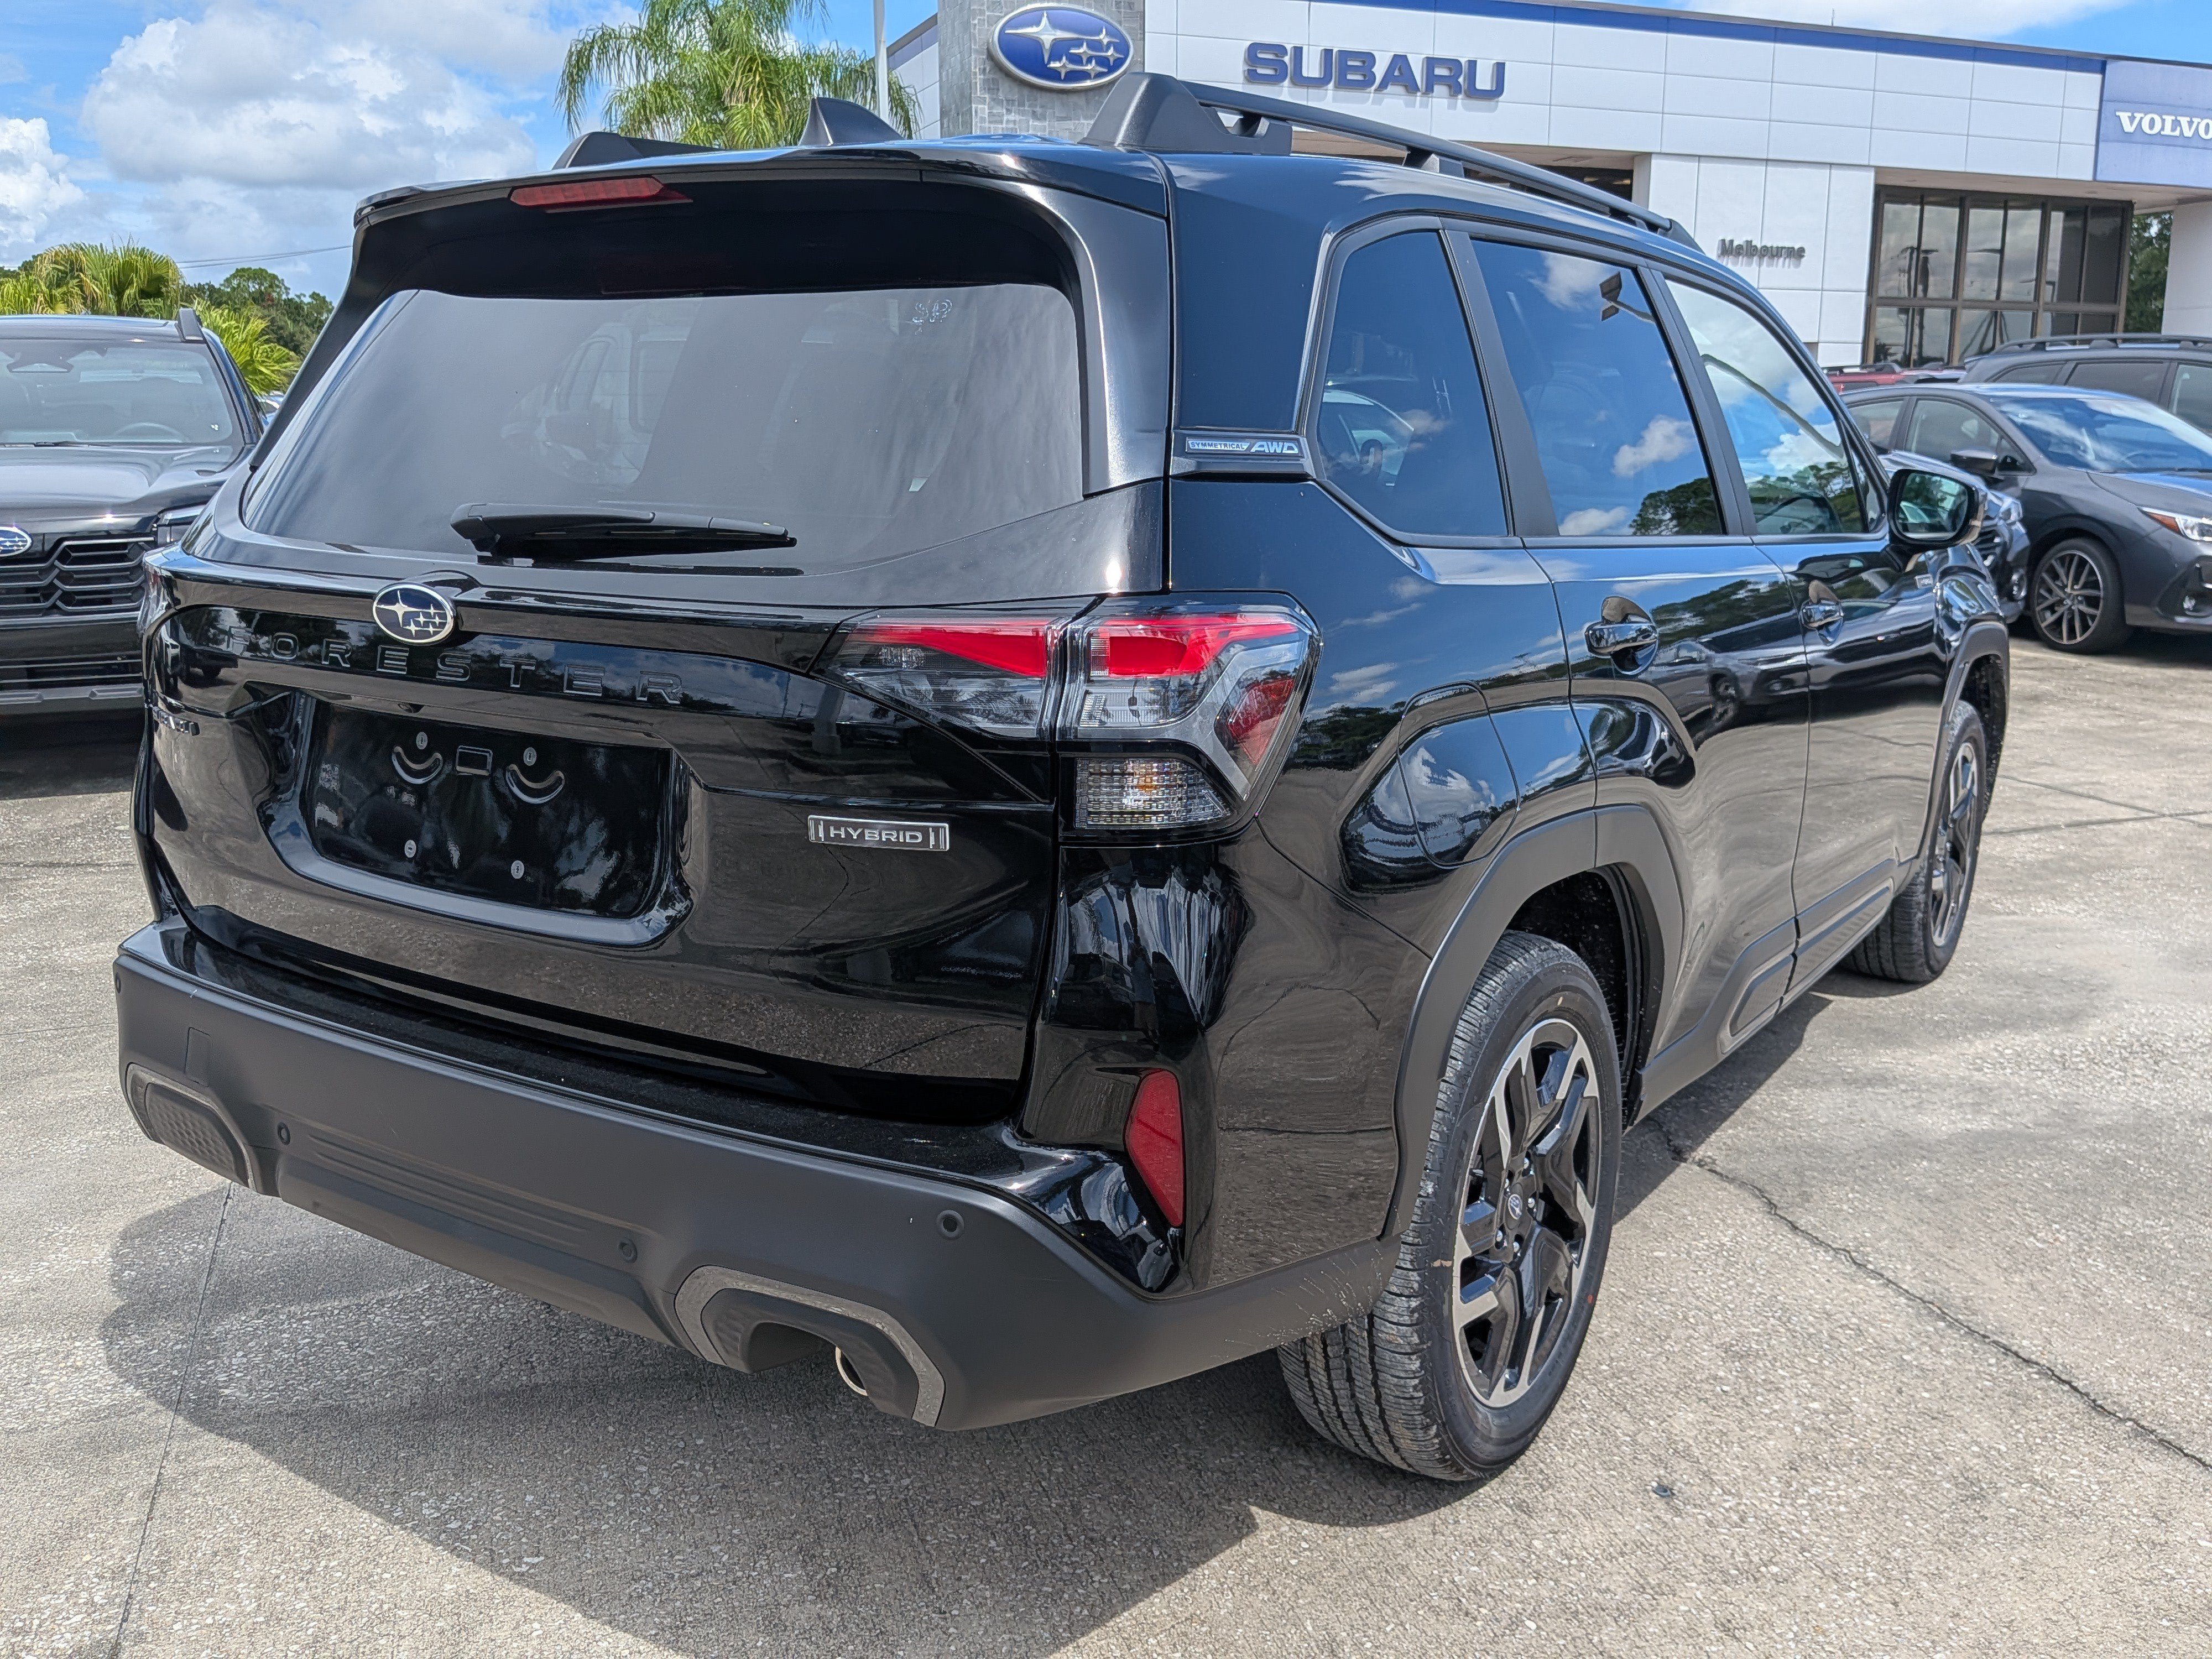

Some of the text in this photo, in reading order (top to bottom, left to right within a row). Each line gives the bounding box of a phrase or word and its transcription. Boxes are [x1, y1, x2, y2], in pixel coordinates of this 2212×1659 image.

[1245, 42, 1506, 100] SUBARU
[2116, 112, 2212, 140] VOLVO
[1717, 239, 1806, 259] Melbourne
[1191, 441, 1298, 453] SYMMETRICAL AWD
[226, 625, 682, 706] FORESTER
[830, 825, 923, 843] HYBRID
